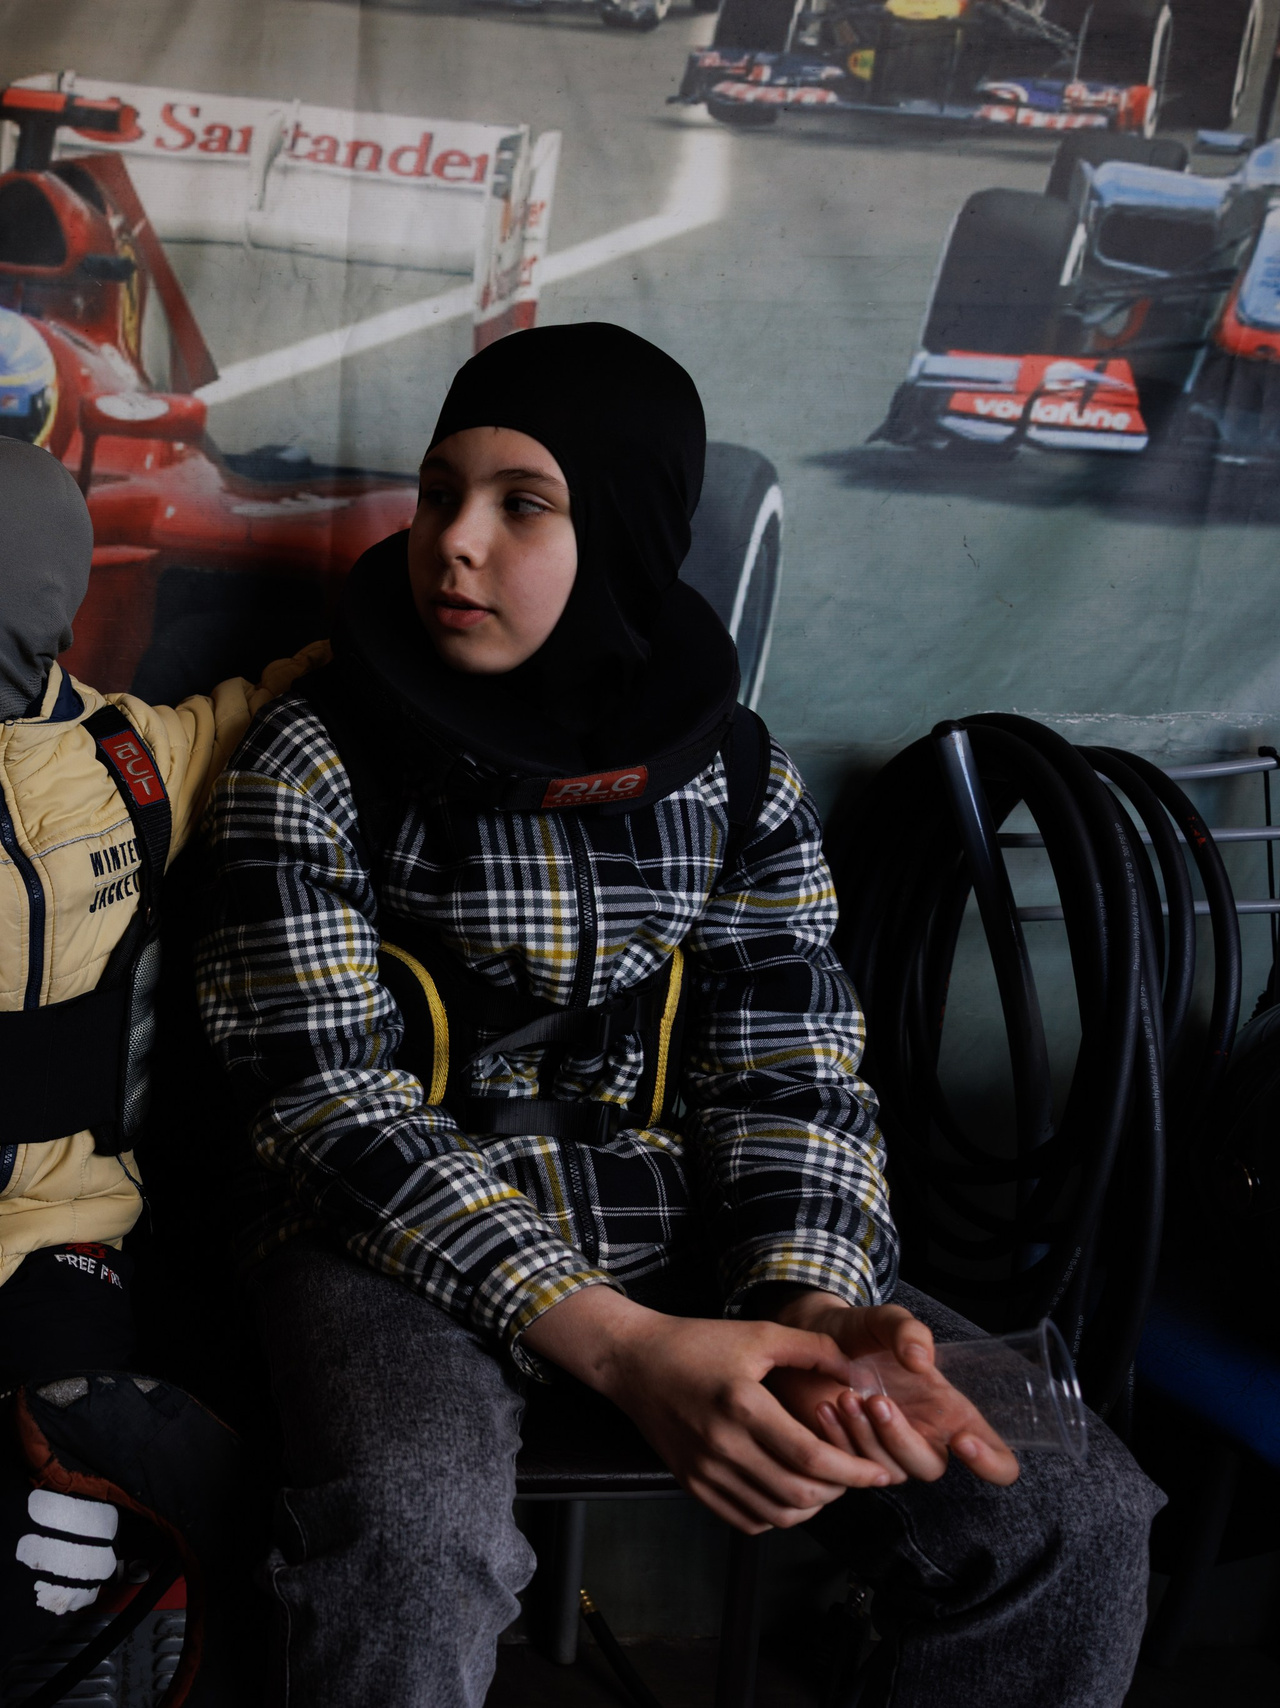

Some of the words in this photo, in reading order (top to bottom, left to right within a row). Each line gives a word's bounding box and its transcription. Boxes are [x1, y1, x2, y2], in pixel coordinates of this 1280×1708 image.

[553, 774, 641, 798] RLG
[1121, 845, 1130, 857] 300
[1125, 861, 1133, 869] ID
[1131, 906, 1139, 917] Air
[1140, 997, 1149, 1011] 300
[1142, 1016, 1151, 1024] ID
[1150, 1064, 1158, 1076] Air
[1152, 1076, 1160, 1099] Hybrid
[1153, 1100, 1161, 1131] Premium
[53, 1253, 98, 1275] FREE
